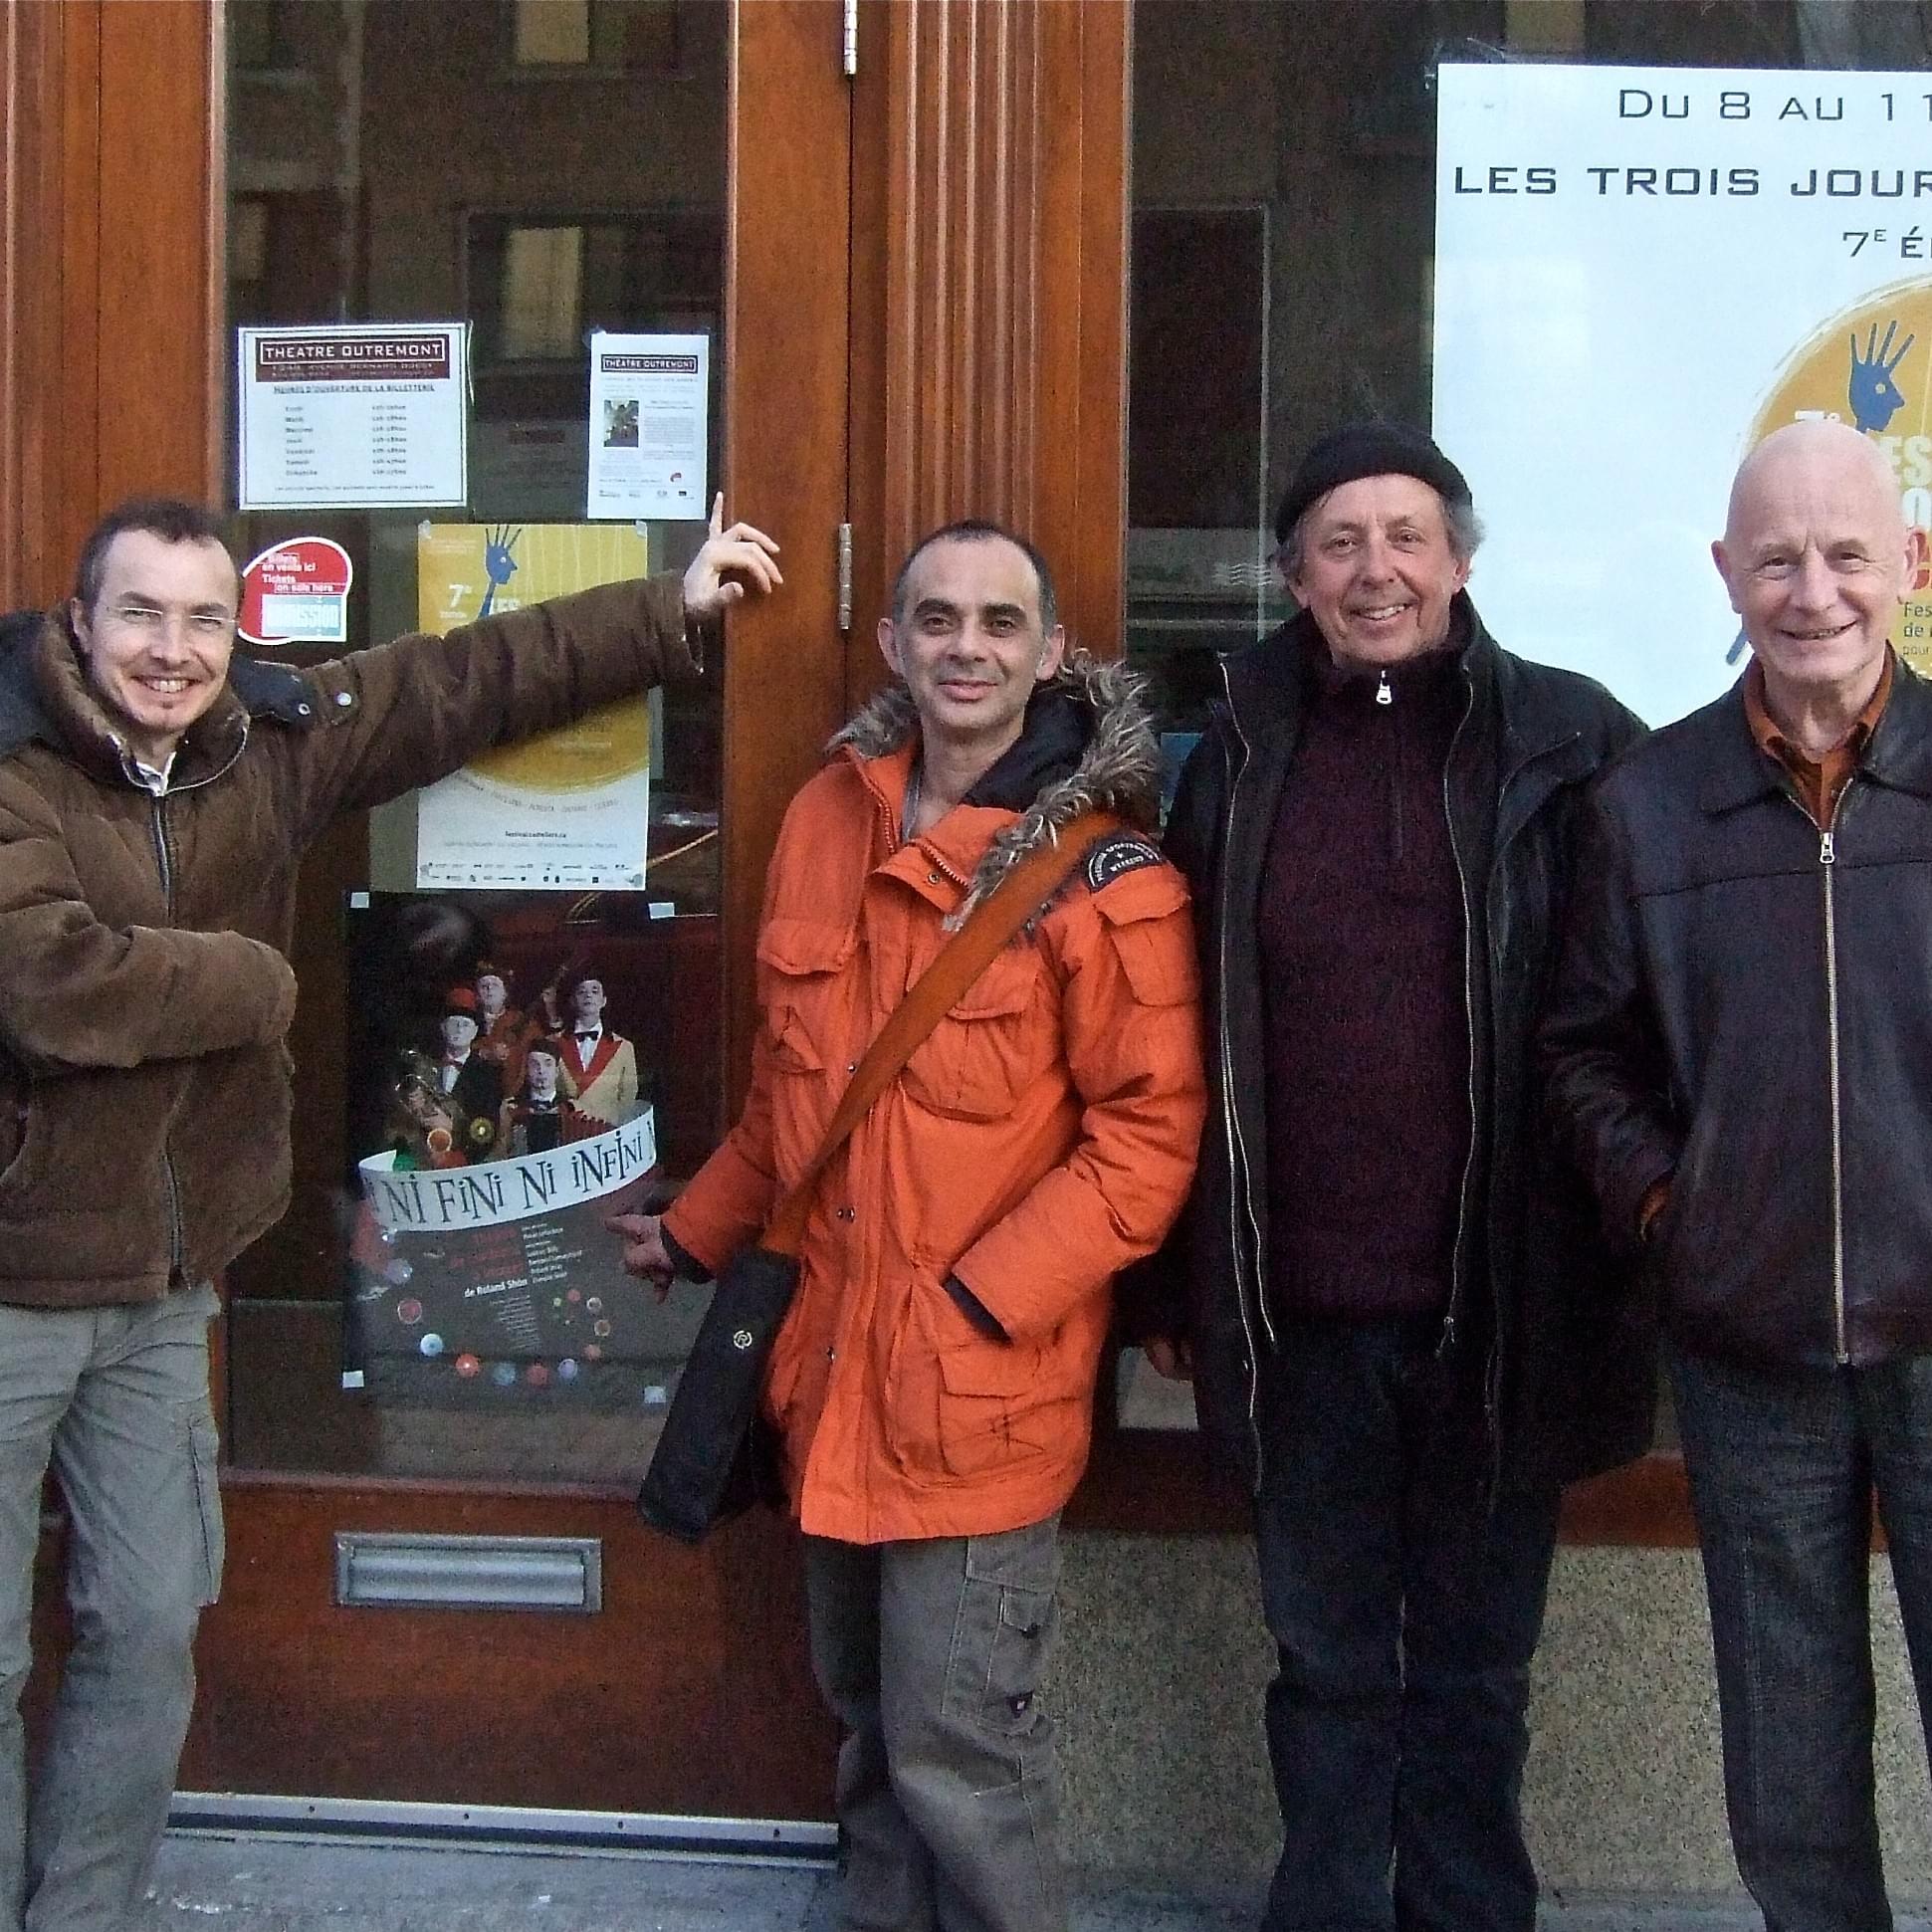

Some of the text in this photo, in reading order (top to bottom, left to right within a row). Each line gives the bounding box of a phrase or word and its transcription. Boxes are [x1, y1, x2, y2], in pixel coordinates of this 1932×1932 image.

[1719, 91, 1751, 119] 8
[1779, 97, 1843, 121] AU
[1455, 166, 1557, 194] LES
[1588, 167, 1759, 196] TROIS
[1900, 226, 1932, 259] É
[265, 343, 441, 359] THEATRE OUTREMONT
[605, 358, 694, 369] THEATRE OUTREMONT
[262, 573, 297, 583] Tickets
[1903, 621, 1924, 637] de
